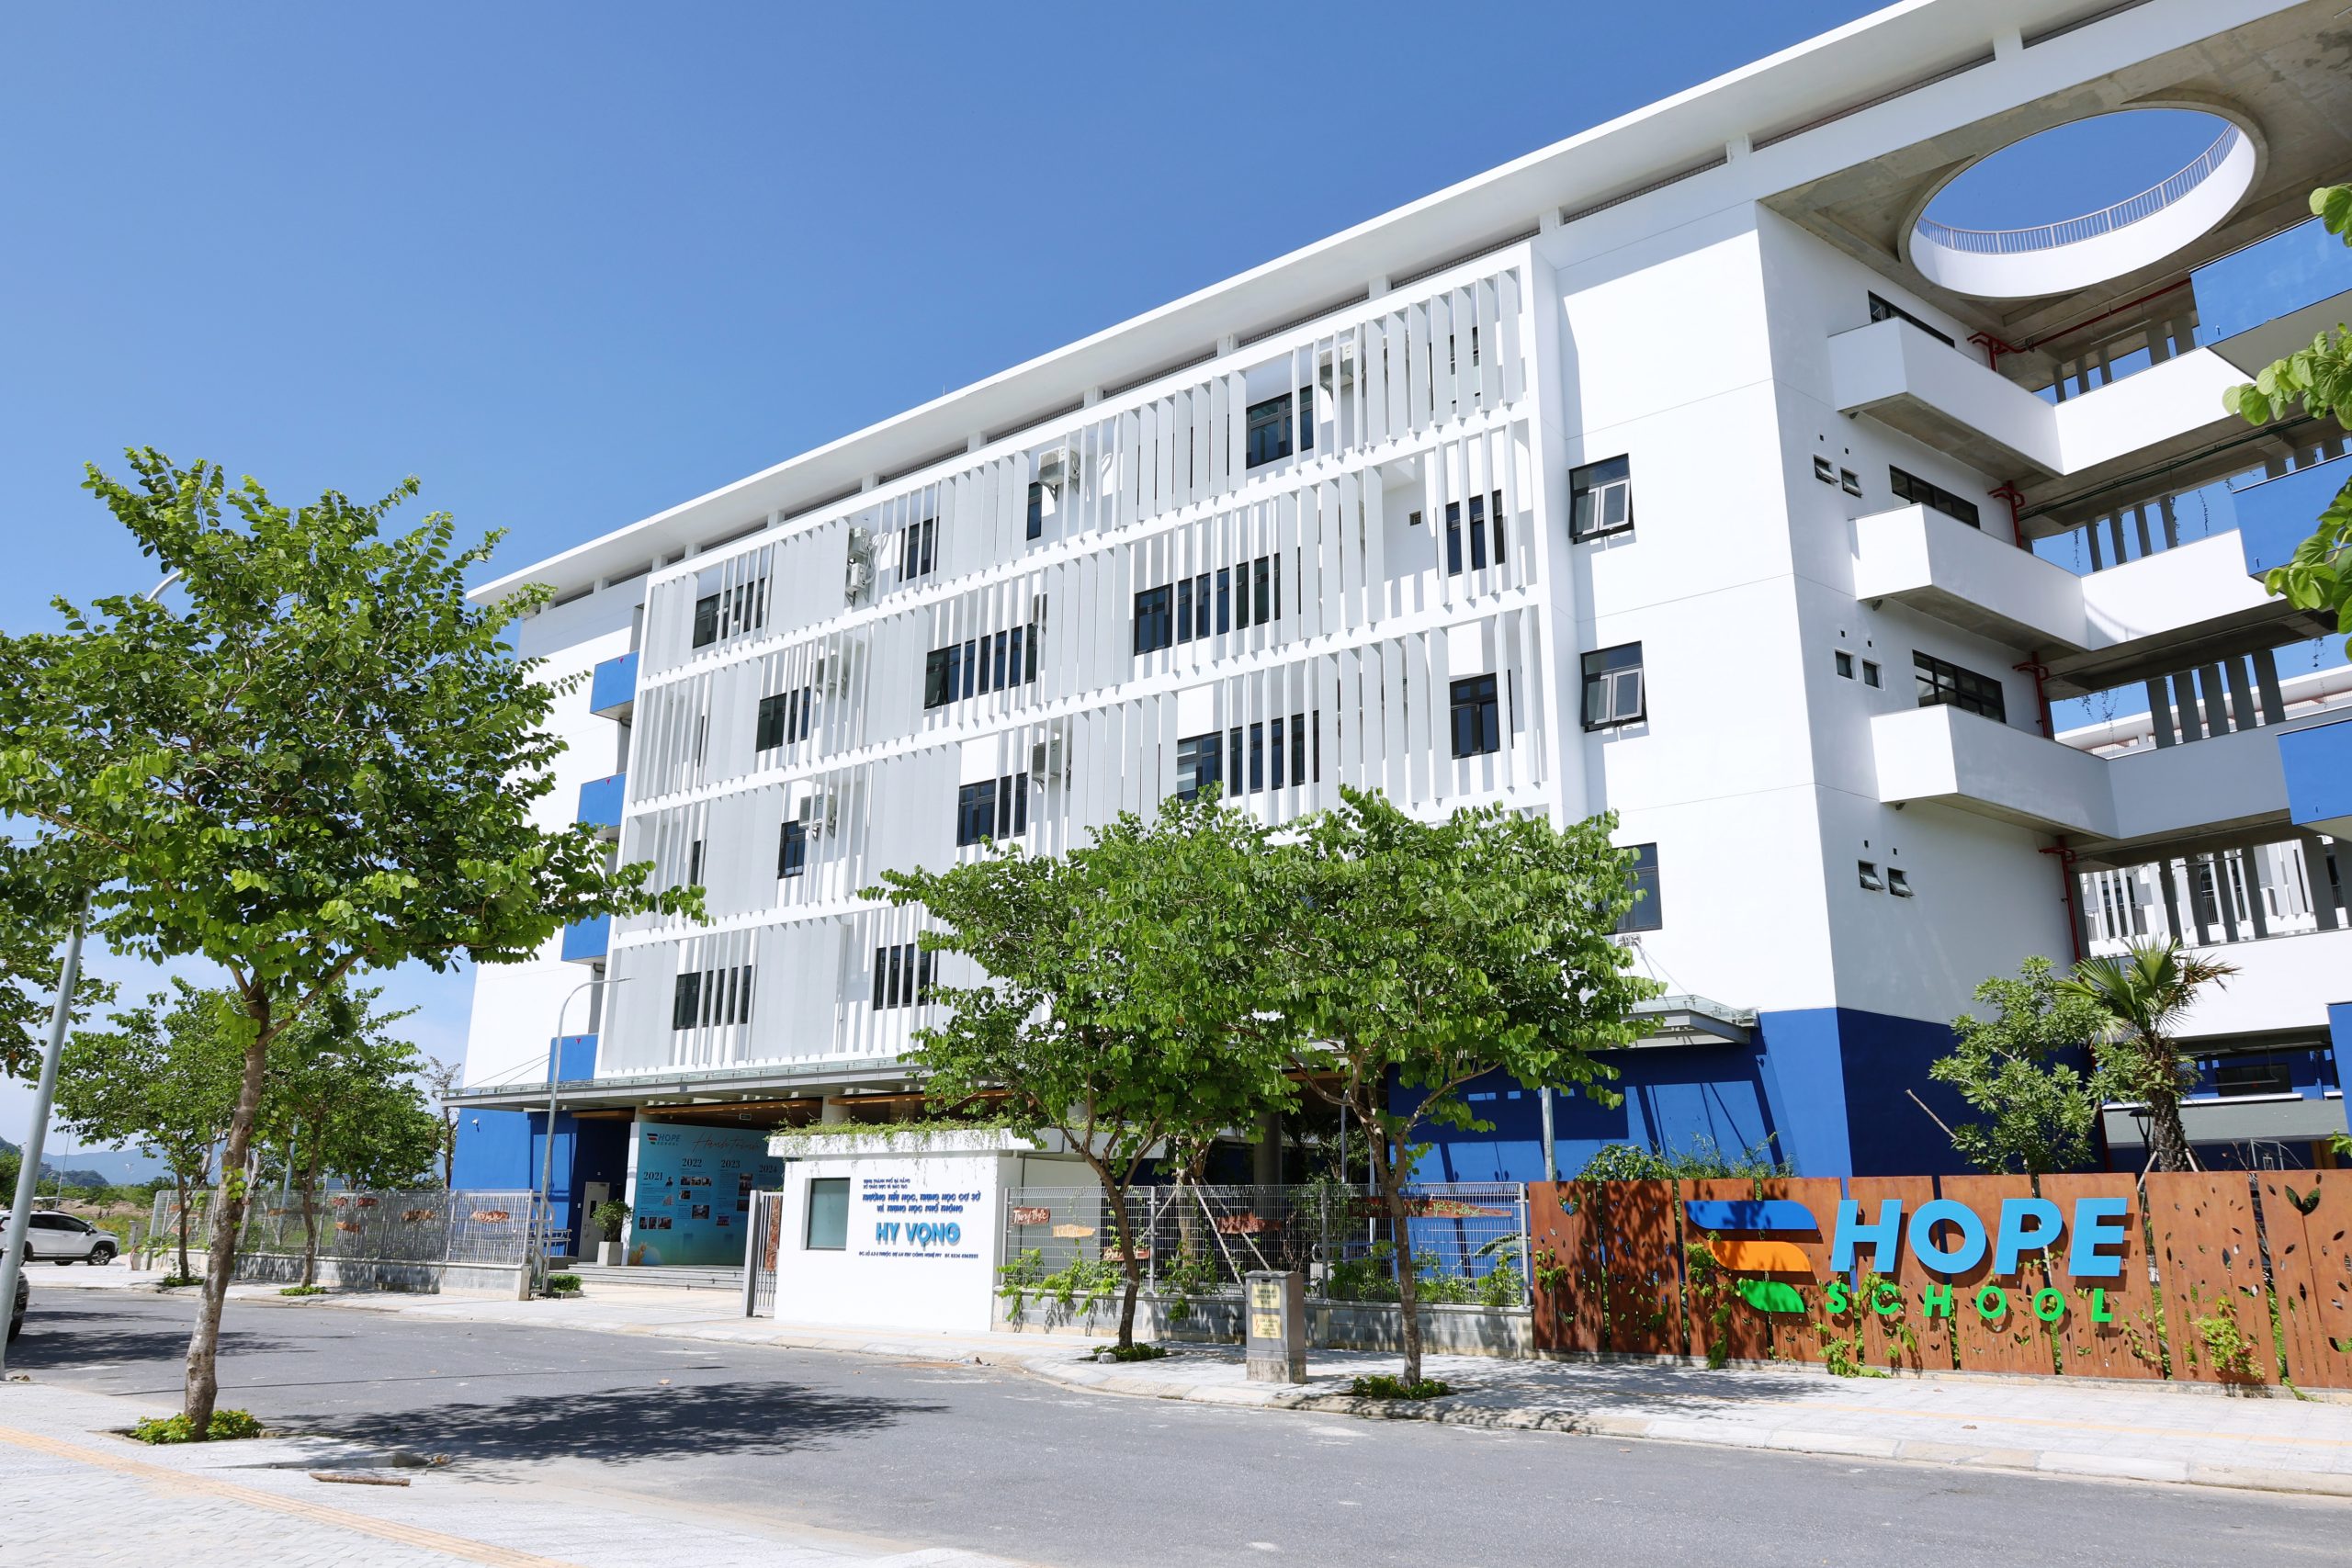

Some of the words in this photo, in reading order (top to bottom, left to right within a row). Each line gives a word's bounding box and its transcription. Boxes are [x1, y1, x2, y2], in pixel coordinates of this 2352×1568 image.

[659, 1134, 681, 1142] HOPE
[682, 1158, 703, 1168] 2022
[720, 1159, 741, 1168] 2023
[643, 1171, 663, 1181] 2021
[876, 1222, 900, 1245] HY
[905, 1222, 961, 1250] VỌNG
[1830, 1197, 2128, 1277] HOPE
[1826, 1281, 2113, 1323] SCHOOL
